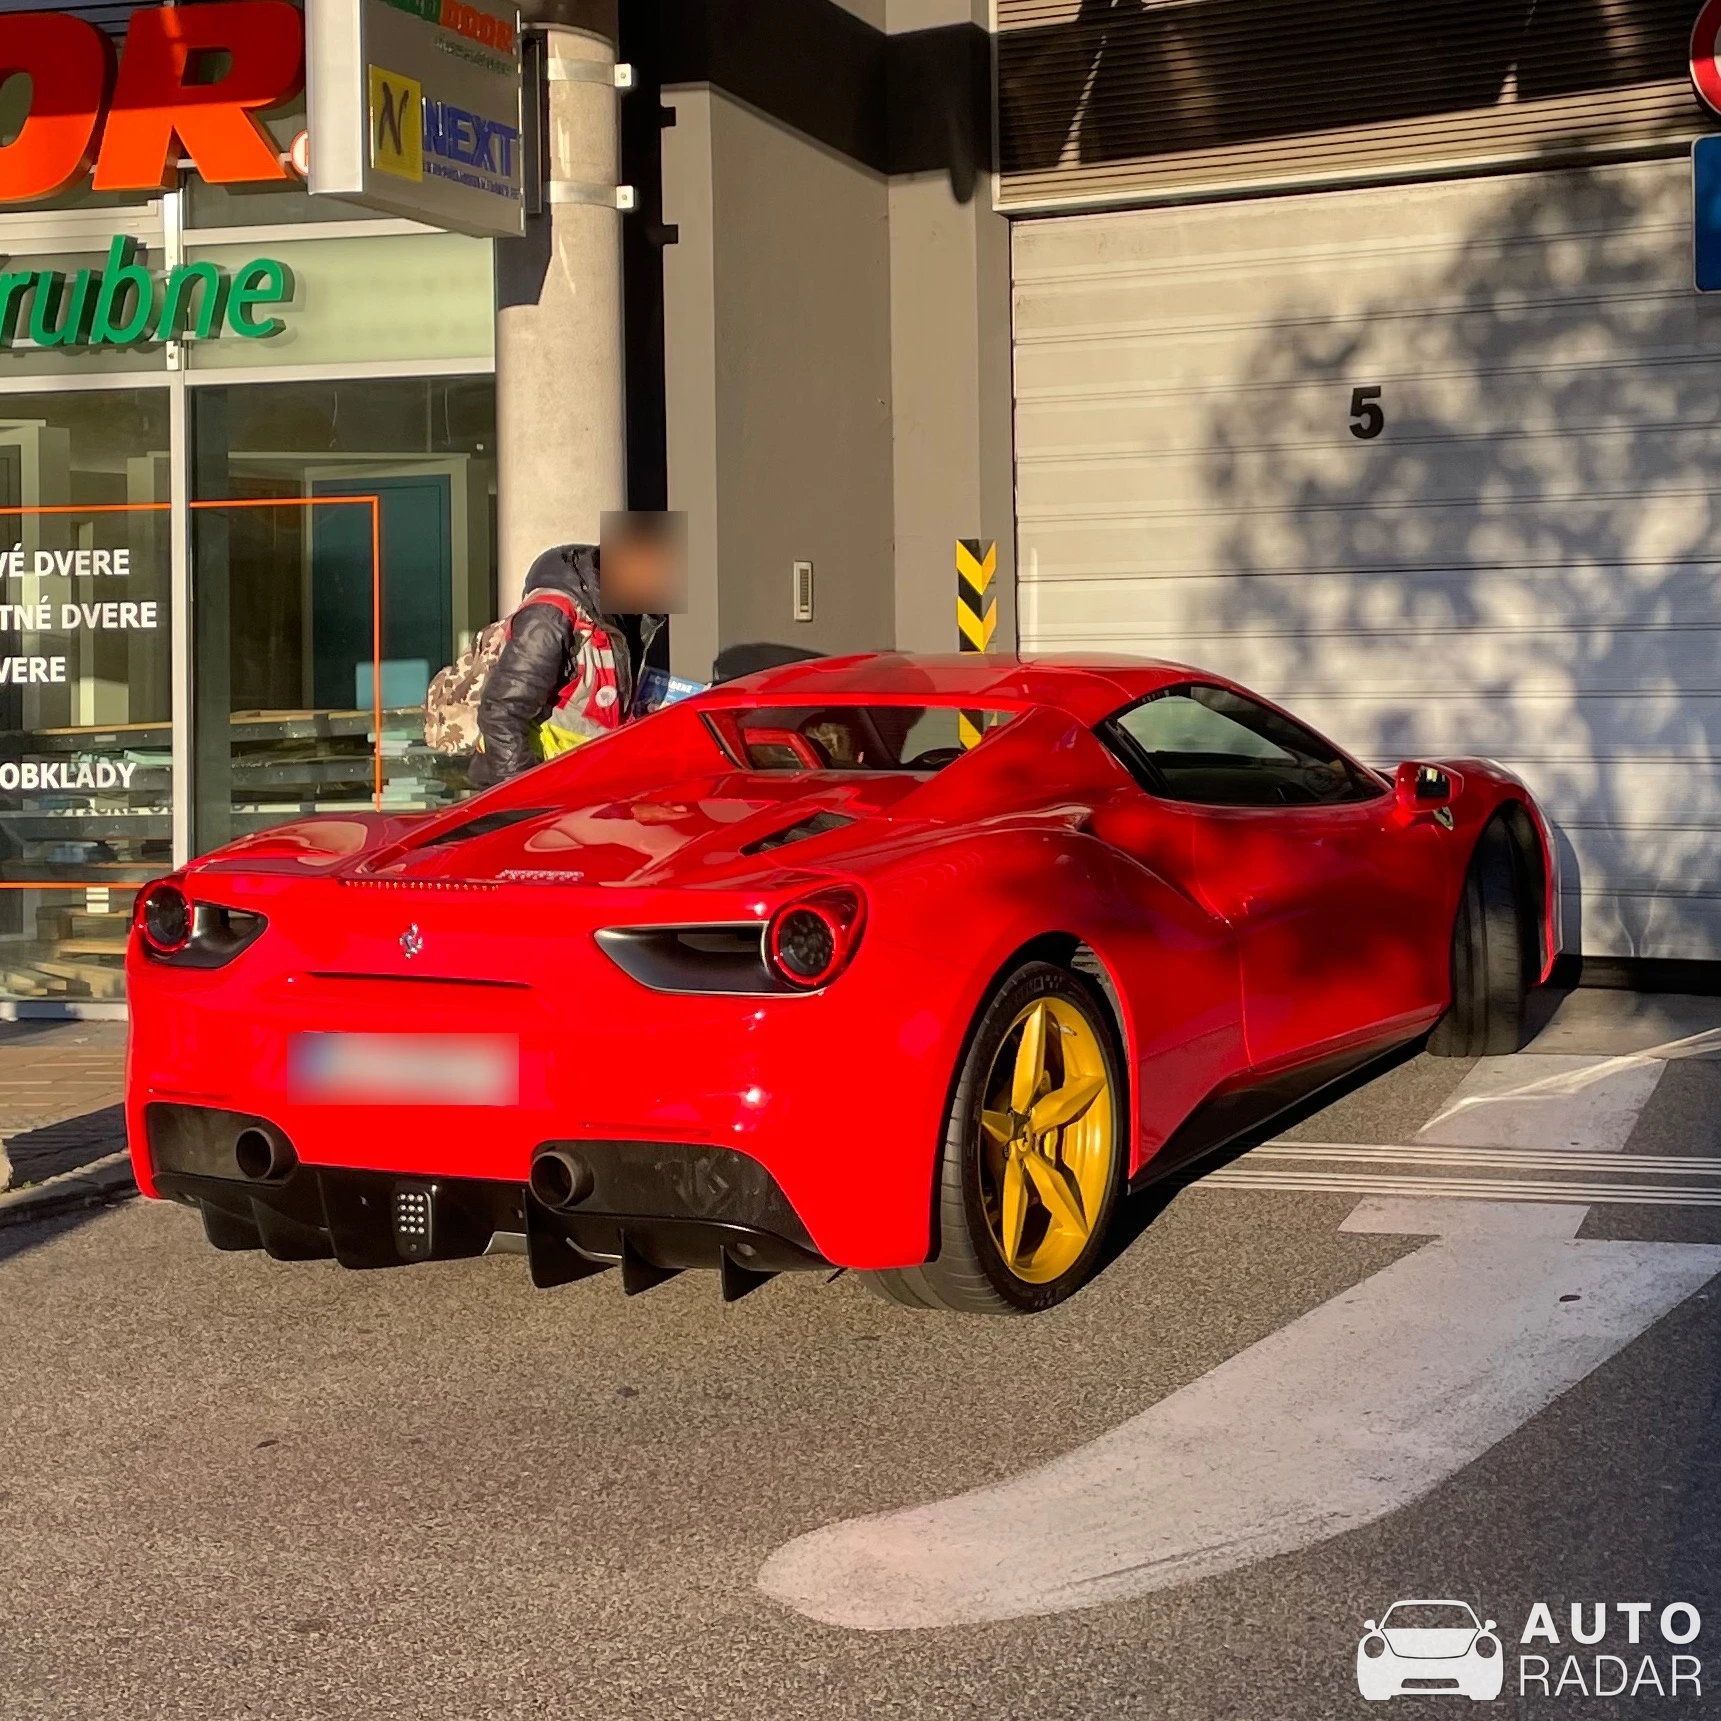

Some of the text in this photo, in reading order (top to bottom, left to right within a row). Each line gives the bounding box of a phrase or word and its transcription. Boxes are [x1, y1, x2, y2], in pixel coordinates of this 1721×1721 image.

[422, 96, 518, 178] NEXT
[1349, 385, 1384, 438] 5
[34, 549, 130, 576] DVERE
[0, 595, 157, 630] TNÉ DVERE
[0, 763, 136, 789] OBKLADY
